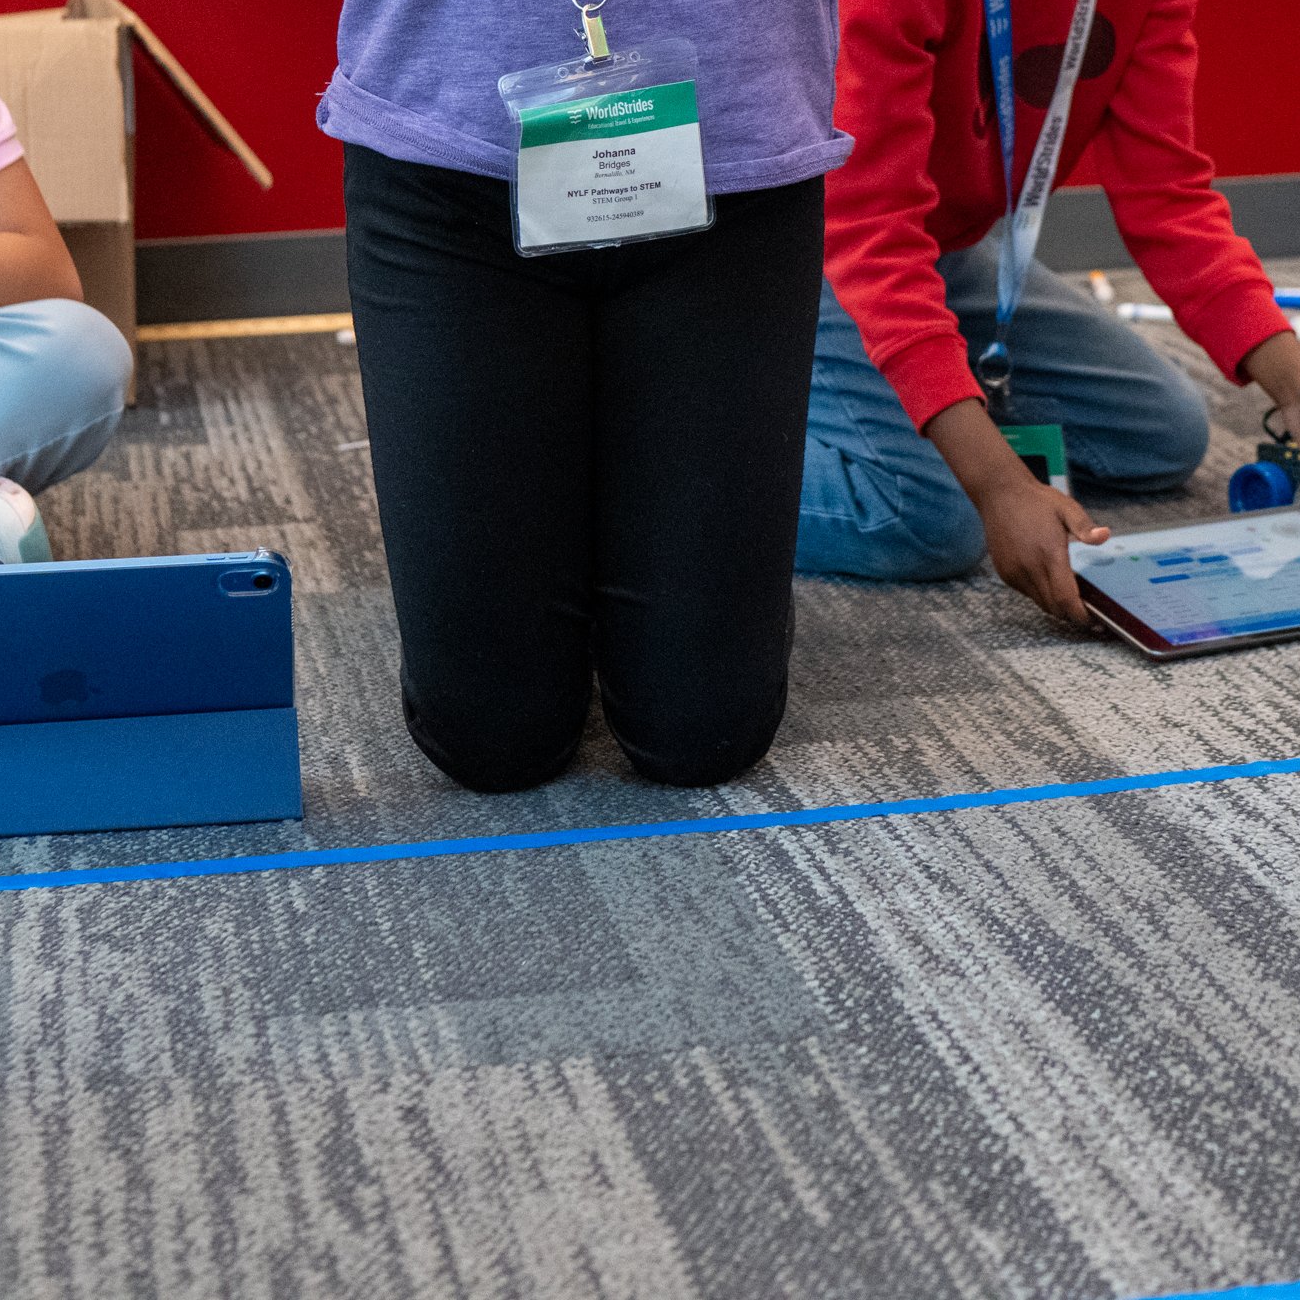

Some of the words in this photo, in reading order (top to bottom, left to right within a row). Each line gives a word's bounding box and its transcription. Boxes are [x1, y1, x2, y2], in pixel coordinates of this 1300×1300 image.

[586, 99, 653, 120] WorldStrides
[592, 147, 636, 159] Johanna
[598, 160, 631, 170] Bridges
[567, 189, 589, 198] NYLF
[590, 187, 629, 196] Pathways
[640, 181, 661, 190] STEM
[592, 196, 613, 205] STEM
[614, 195, 634, 203] Group
